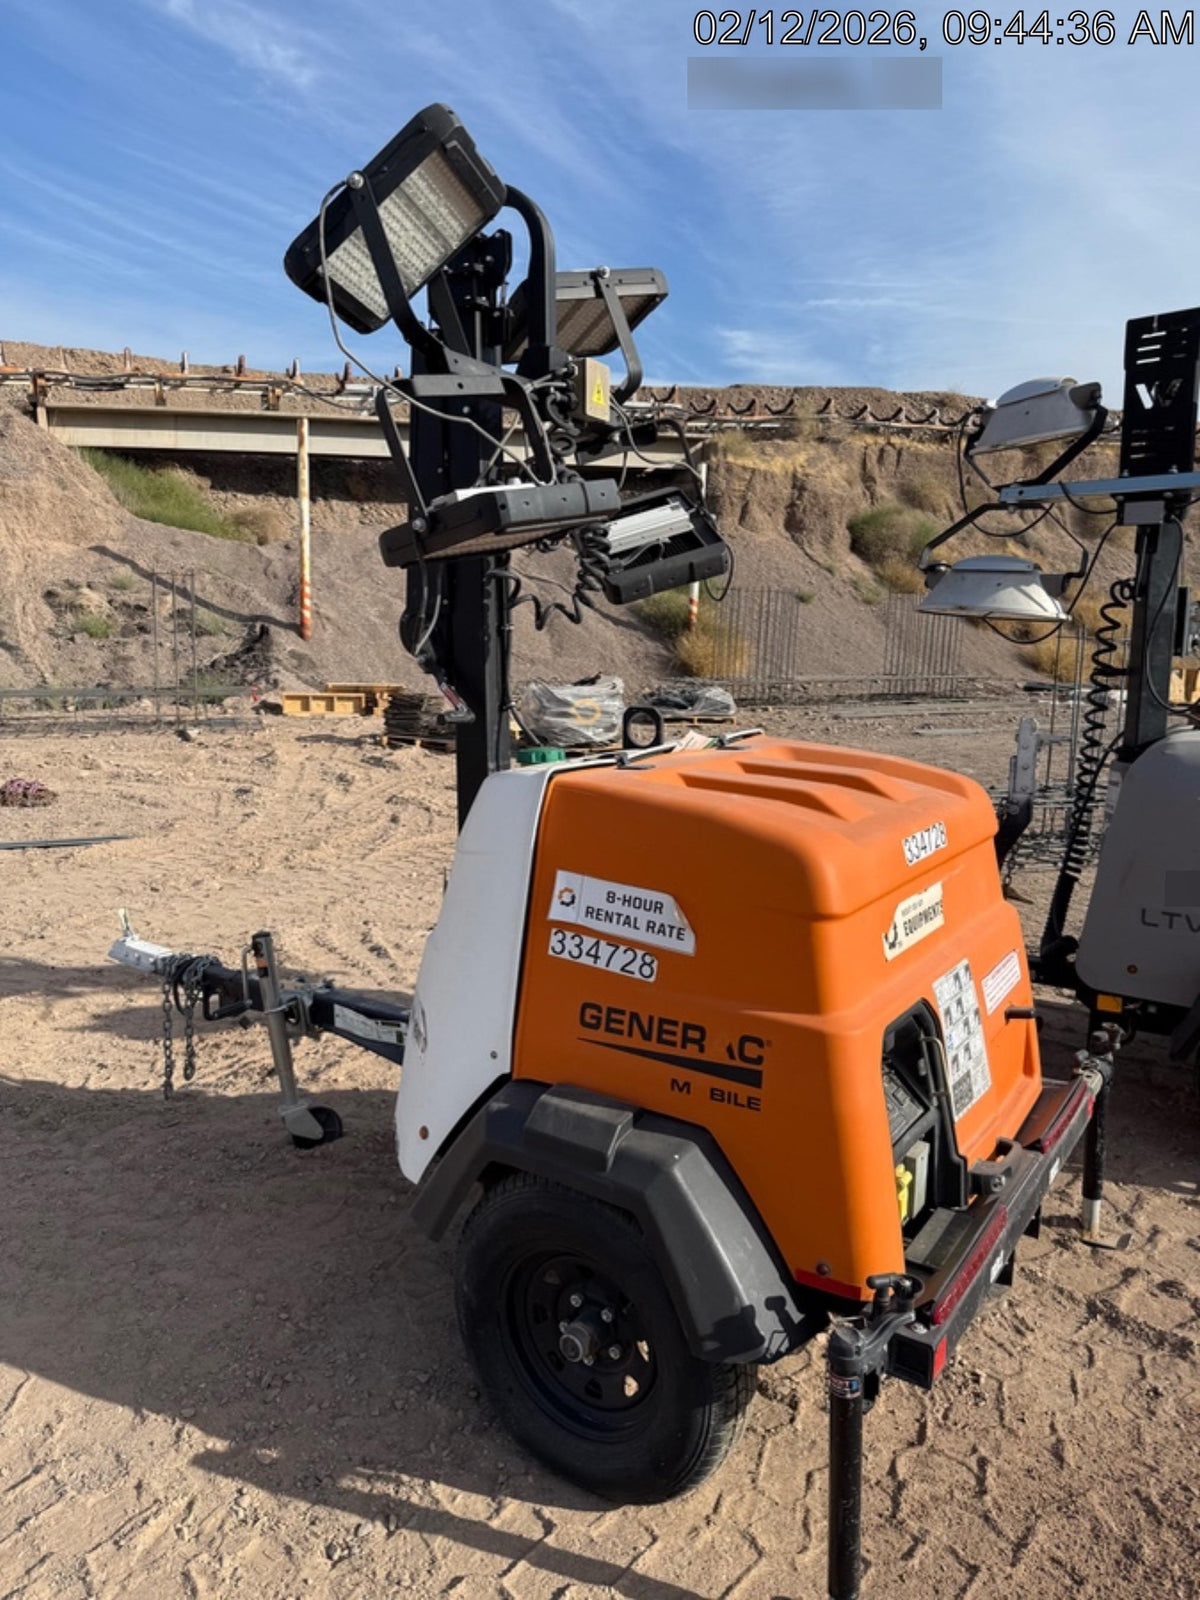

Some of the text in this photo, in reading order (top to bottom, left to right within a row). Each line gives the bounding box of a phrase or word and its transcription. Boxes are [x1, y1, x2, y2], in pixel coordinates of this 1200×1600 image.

[606, 890, 664, 914] 8-HOUR
[584, 906, 686, 941] RENTAL RATE
[550, 929, 656, 979] 334728
[670, 1078, 762, 1112] MBILE
